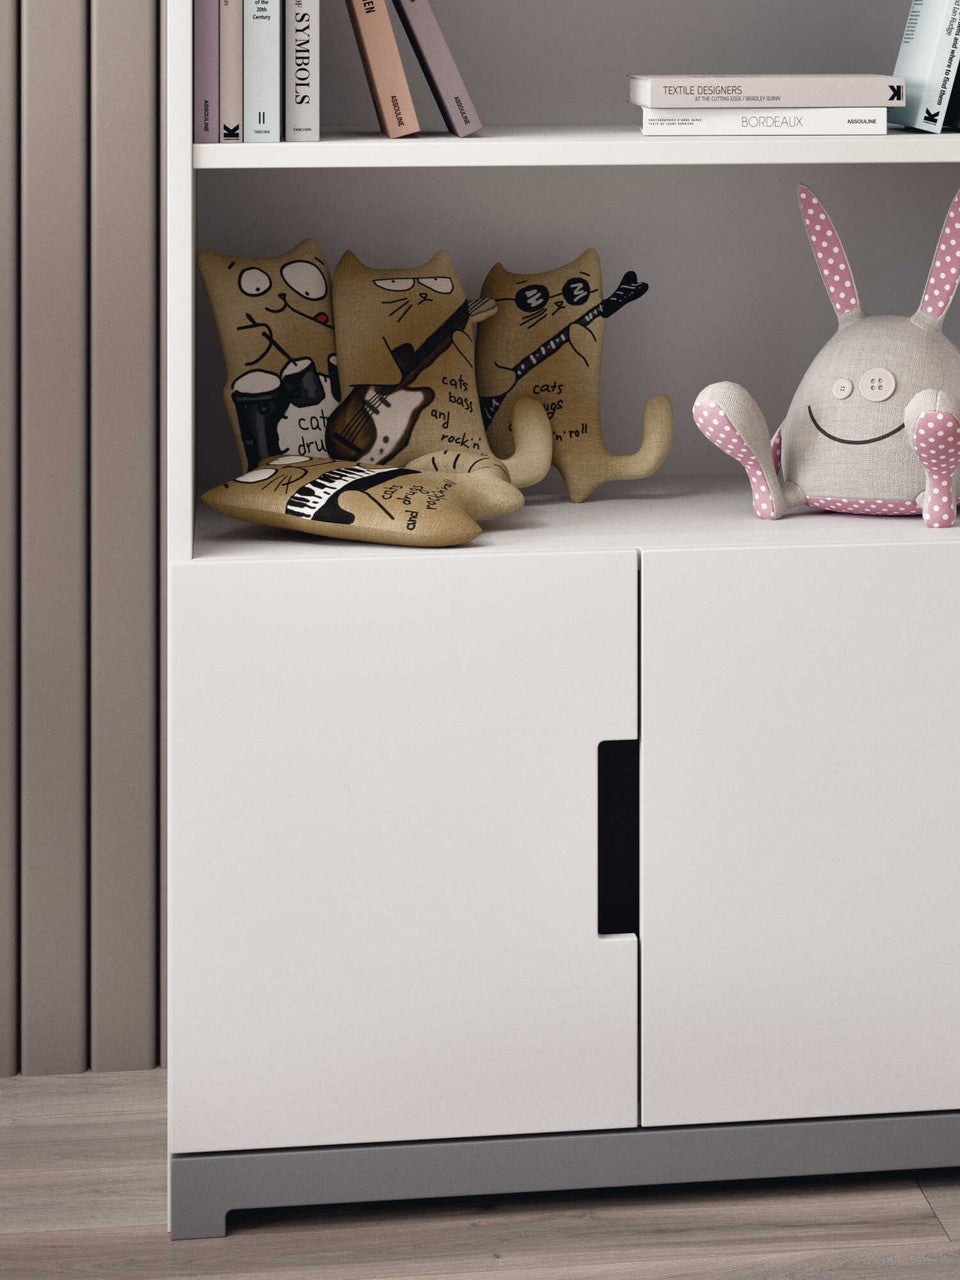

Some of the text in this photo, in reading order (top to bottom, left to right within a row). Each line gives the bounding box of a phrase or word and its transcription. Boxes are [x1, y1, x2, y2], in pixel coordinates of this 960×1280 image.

[952, 37, 960, 49] and
[295, 12, 310, 105] SYMBOLS
[947, 49, 956, 68] where
[944, 68, 951, 76] to
[663, 85, 743, 95] TEXTILE DESIGNERS
[941, 76, 949, 89] find
[937, 89, 945, 106] them
[390, 95, 405, 128] ASSOULINE
[454, 96, 471, 126] ASSOULINE
[741, 116, 803, 128] BORDEAUX
[441, 374, 468, 391] cats
[533, 381, 564, 395] cats
[448, 391, 473, 413] bass
[298, 409, 327, 431] cat
[430, 409, 450, 429] and
[381, 484, 403, 500] cats
[396, 484, 430, 505] drugs
[405, 510, 420, 531] and
